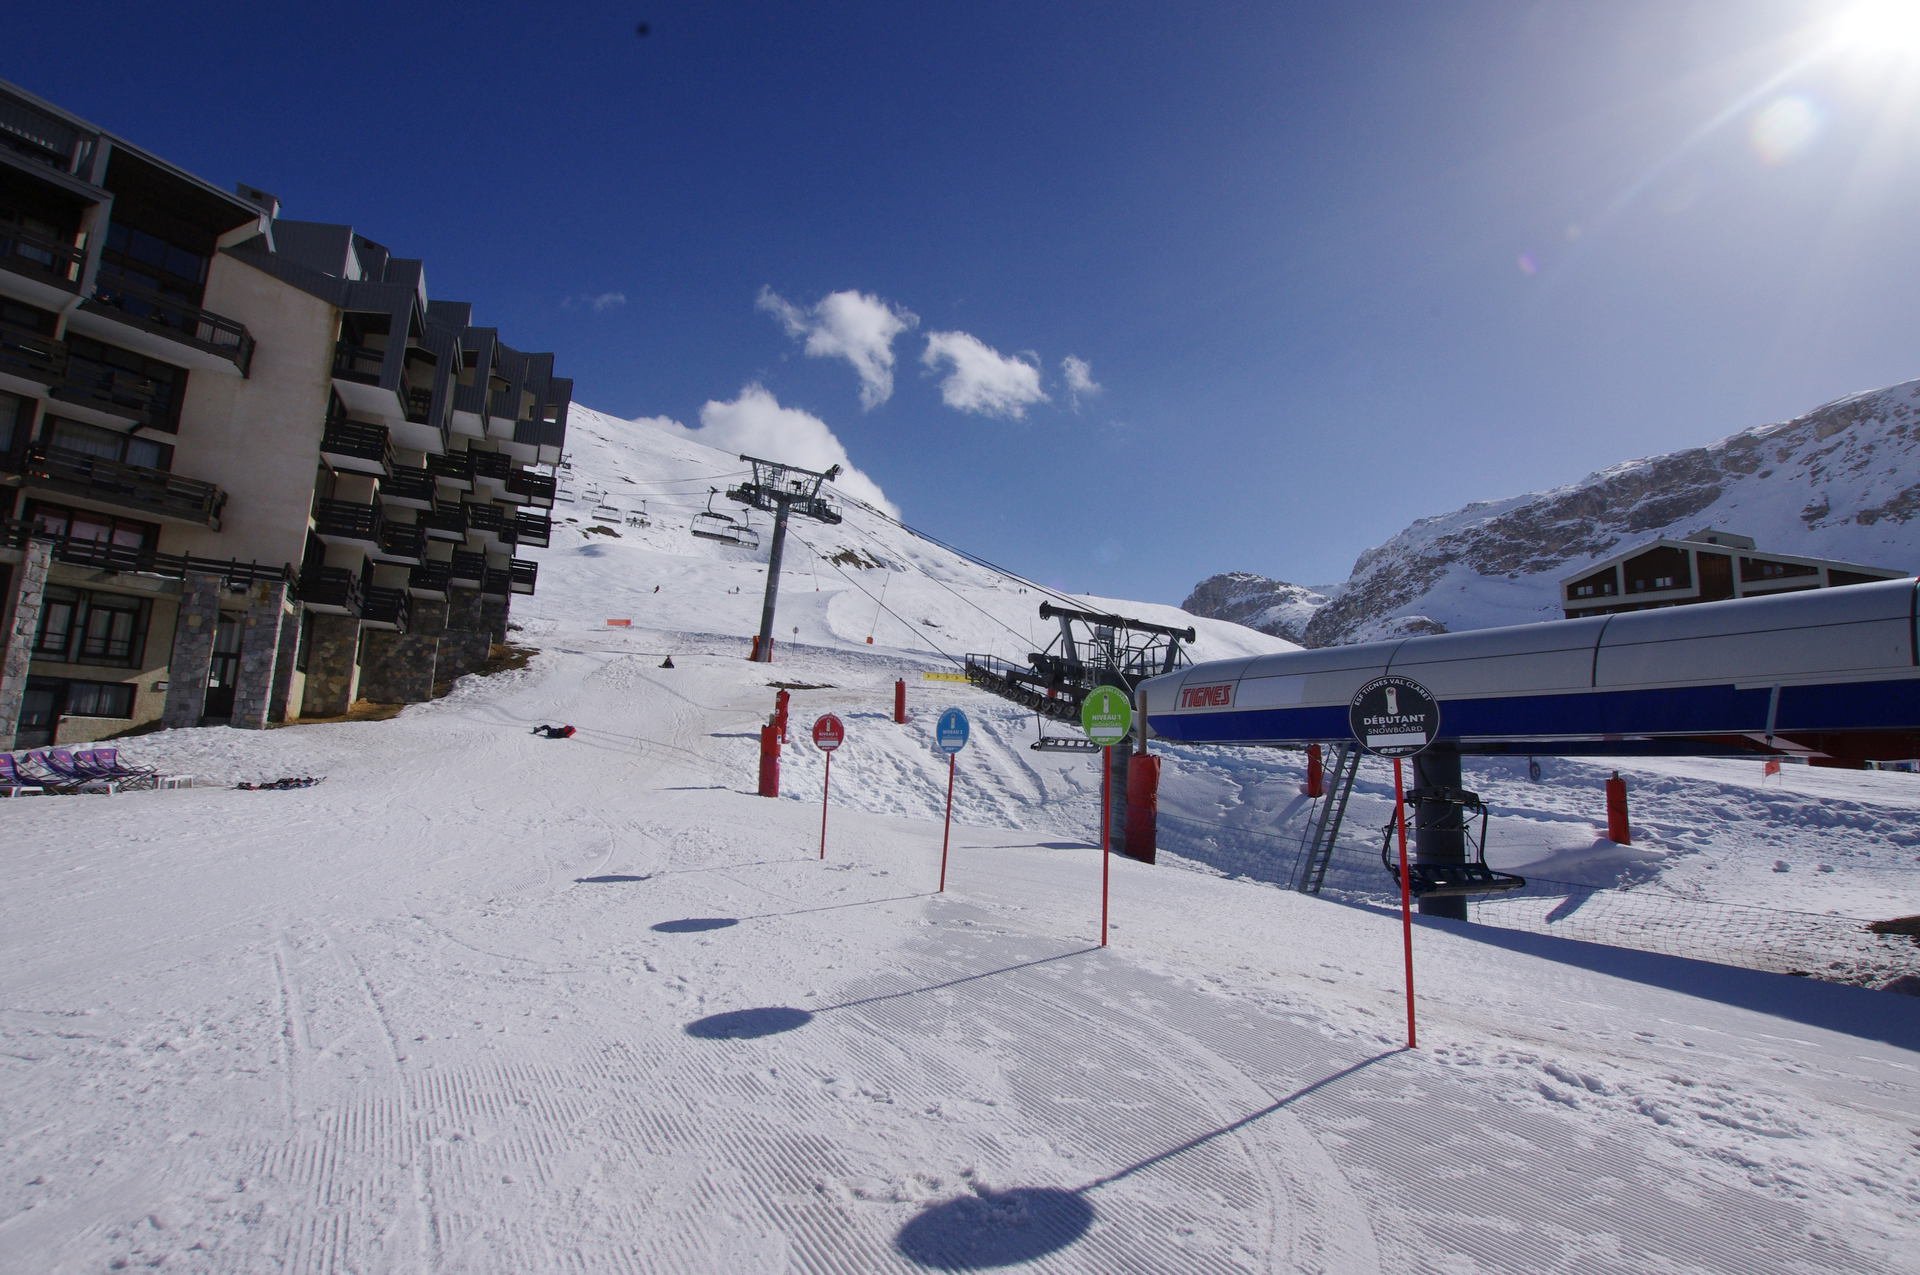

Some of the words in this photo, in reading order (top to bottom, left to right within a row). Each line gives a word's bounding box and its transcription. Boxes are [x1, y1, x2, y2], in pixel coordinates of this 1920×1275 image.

[1181, 684, 1233, 708] TIGNES
[1363, 679, 1388, 695] TIGNES
[1406, 681, 1432, 702] CLARET
[1363, 714, 1426, 726] DÉBUTANT
[1367, 725, 1423, 735] SNOWBOARD
